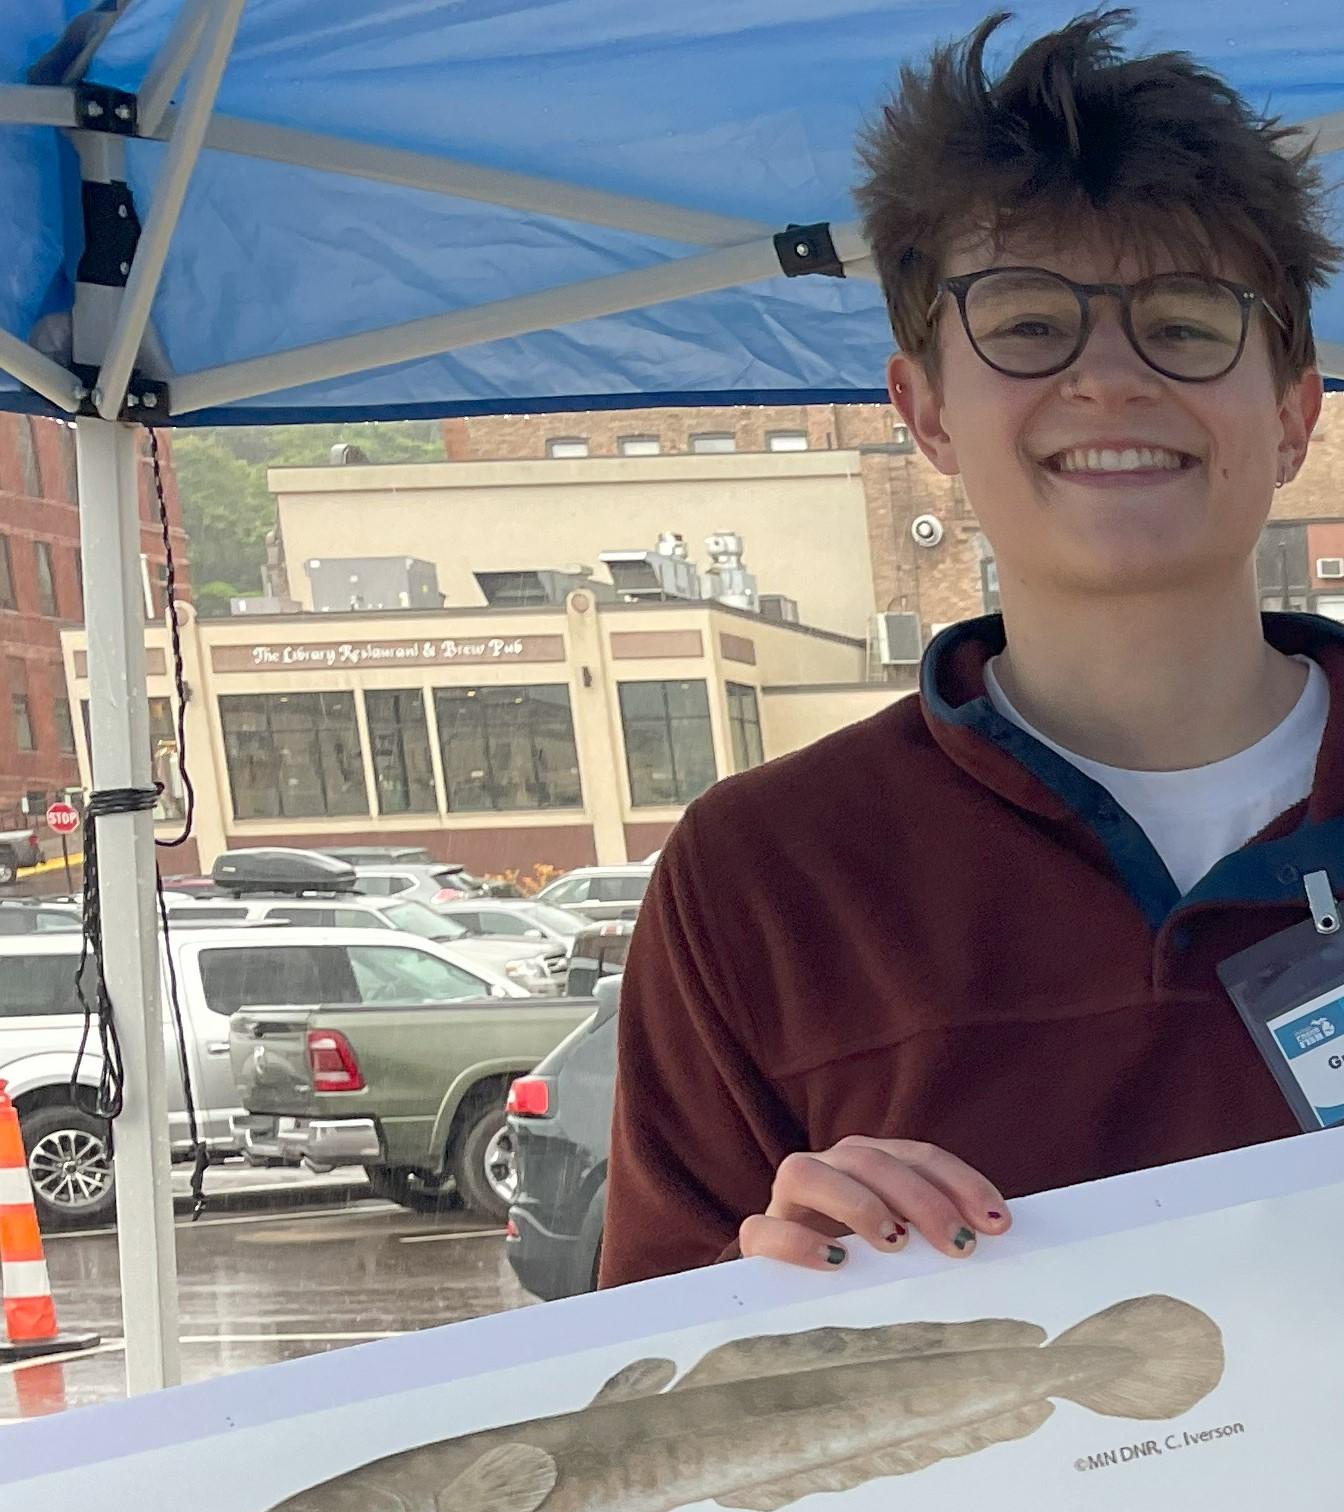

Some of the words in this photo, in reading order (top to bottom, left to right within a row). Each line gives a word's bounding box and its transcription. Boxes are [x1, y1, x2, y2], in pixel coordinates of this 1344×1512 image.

[252, 645, 280, 664] The
[282, 645, 336, 665] Library
[338, 642, 419, 661] Restaurant
[422, 641, 436, 658] &
[440, 640, 485, 657] Brew
[488, 637, 523, 657] Pub
[49, 811, 77, 825] STOP
[1164, 1434, 1182, 1451] C.
[1182, 1422, 1245, 1447] Iverson
